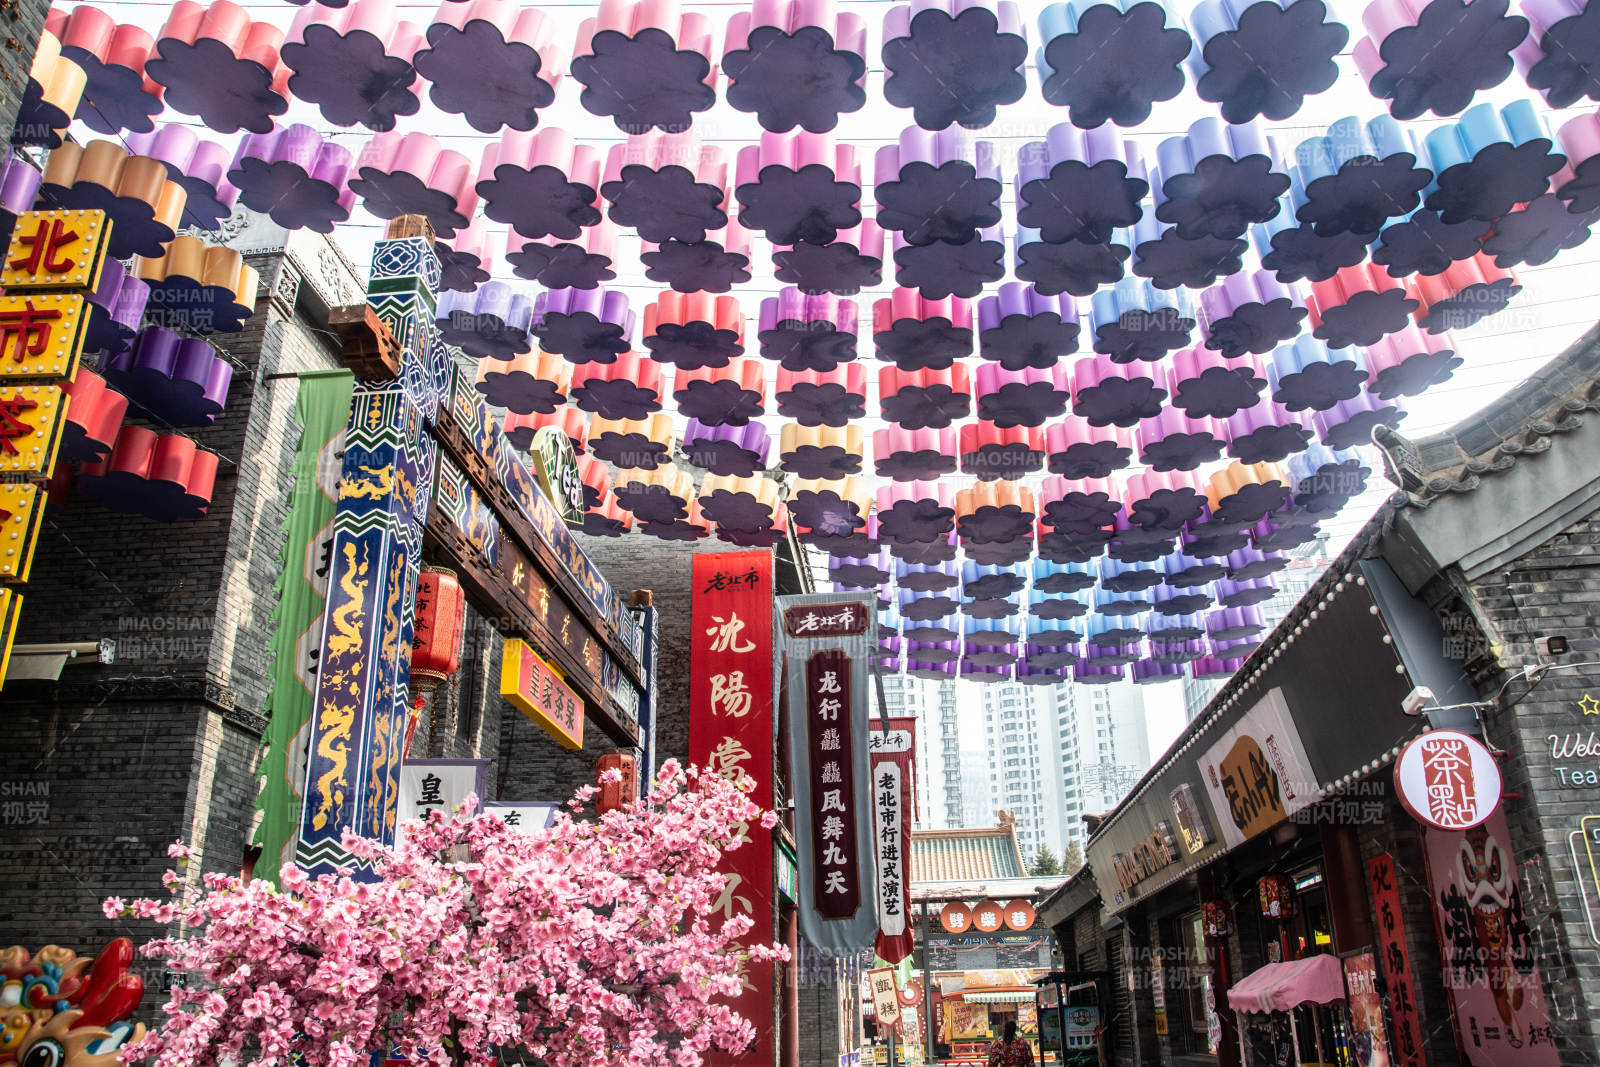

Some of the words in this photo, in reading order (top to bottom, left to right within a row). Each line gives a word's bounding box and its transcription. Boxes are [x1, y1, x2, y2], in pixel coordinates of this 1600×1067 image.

[704, 567, 758, 594] 老北市
[413, 582, 431, 650] 北市茶舍
[796, 606, 854, 634] 老北市
[870, 733, 903, 748] 老北市
[1554, 766, 1600, 785] Tea
[700, 612, 758, 993] 沈陽當不
[504, 811, 521, 826] 左
[879, 773, 900, 915] 老北市行进式演艺
